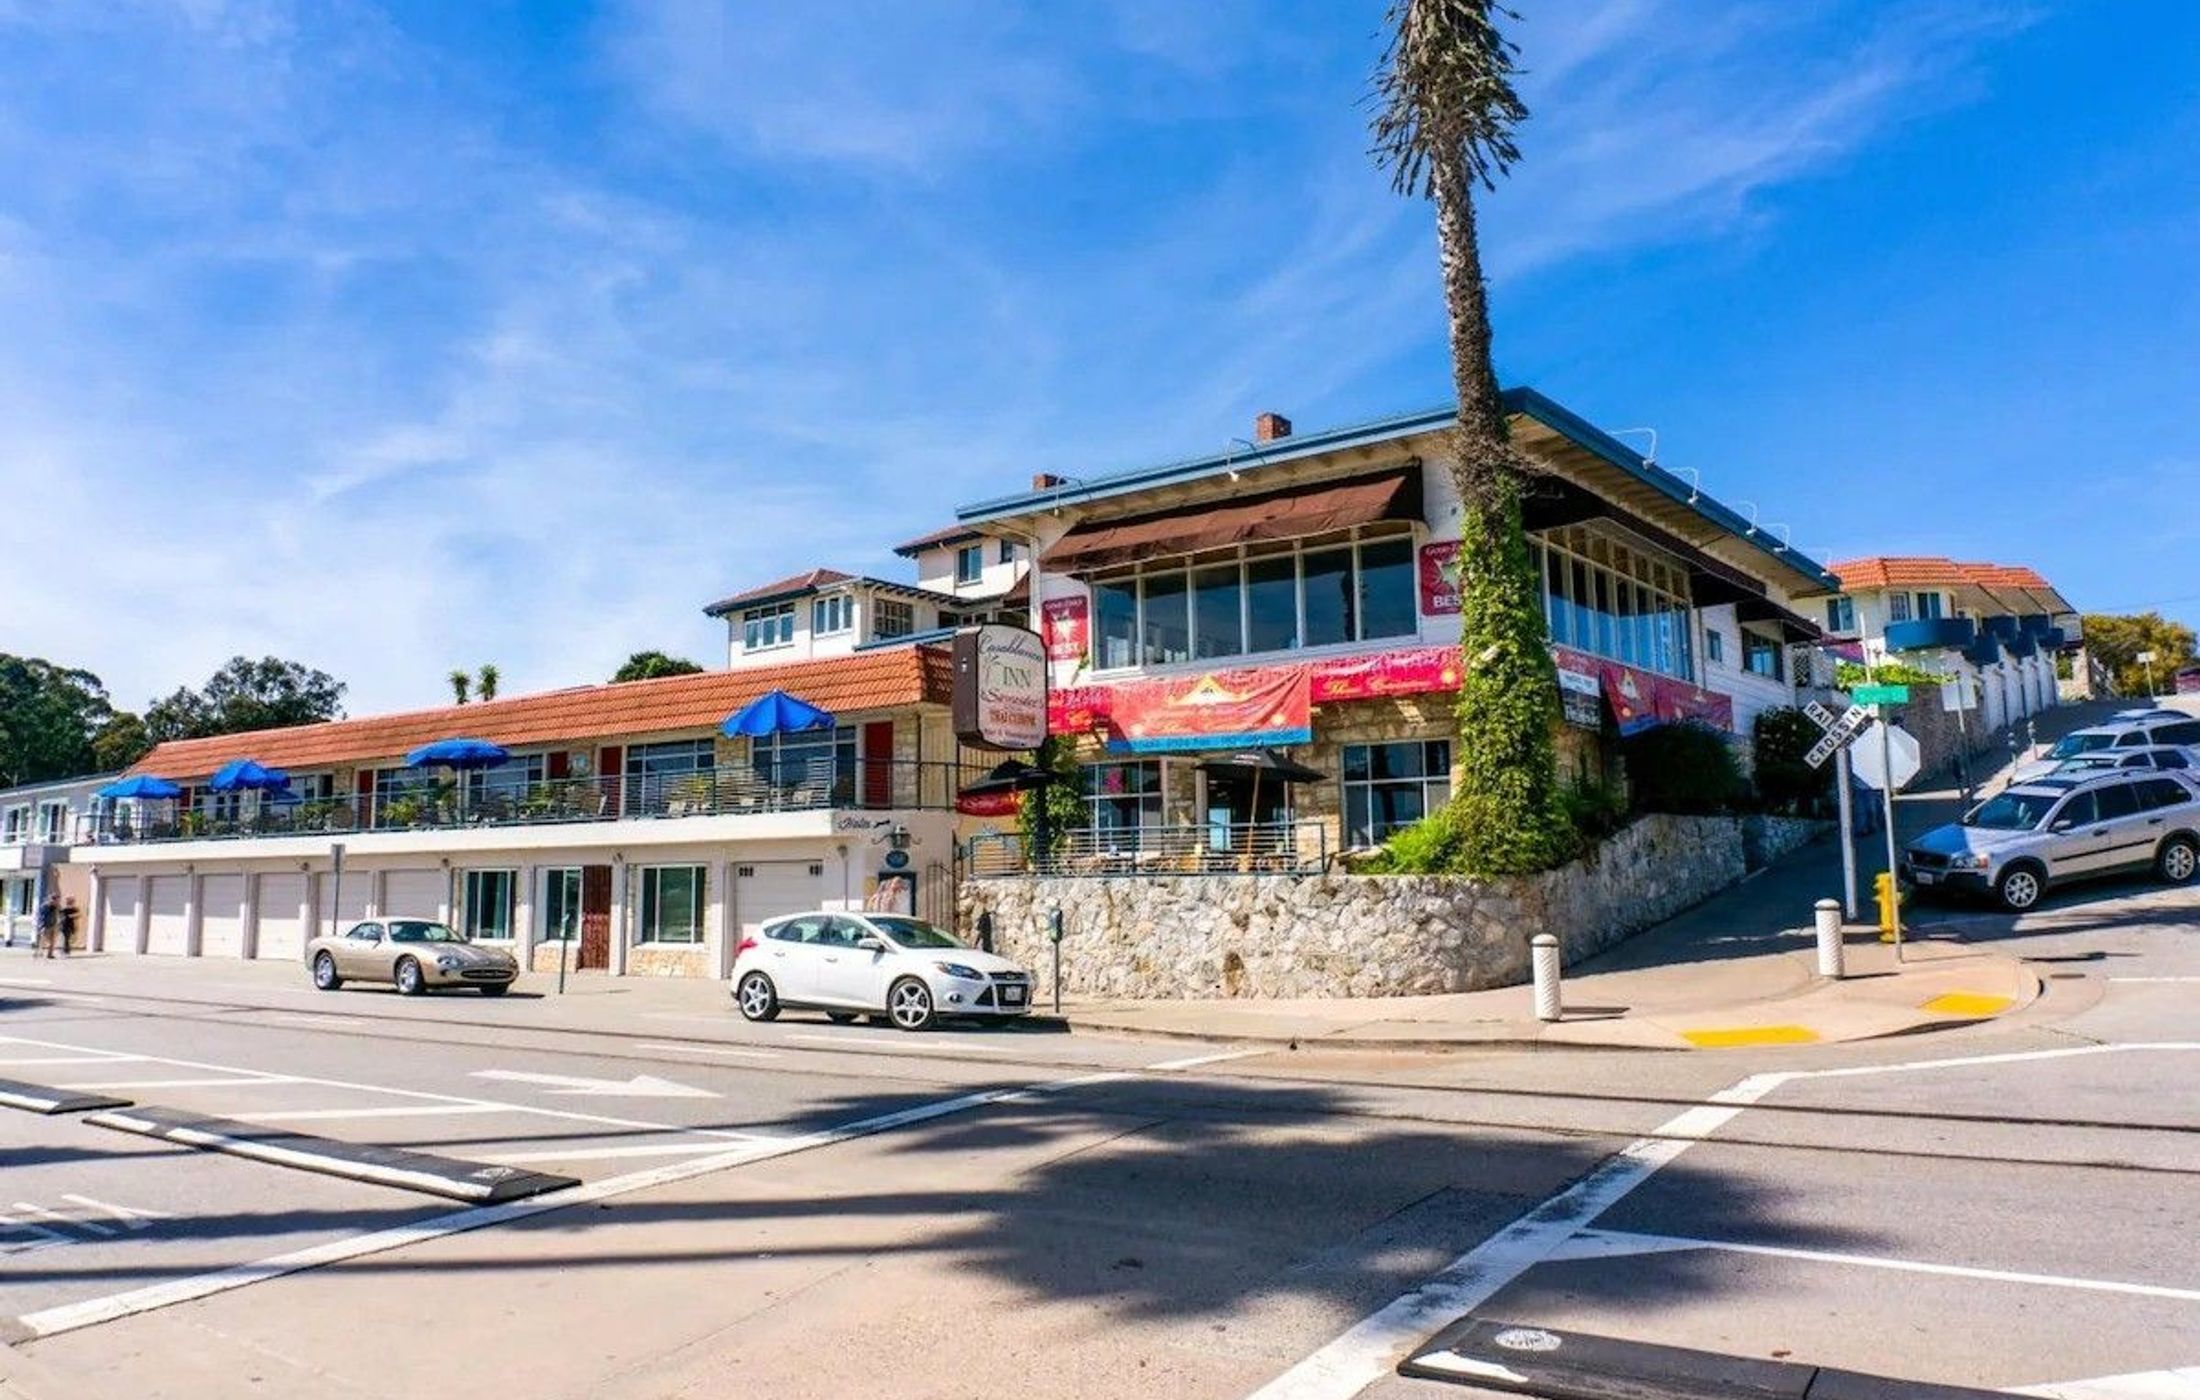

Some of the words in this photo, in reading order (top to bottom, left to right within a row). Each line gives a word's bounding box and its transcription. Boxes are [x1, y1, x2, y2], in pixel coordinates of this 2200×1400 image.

[1433, 595, 1460, 608] BES
[1003, 666, 1032, 688] INN
[1808, 704, 1834, 730] RAIL
